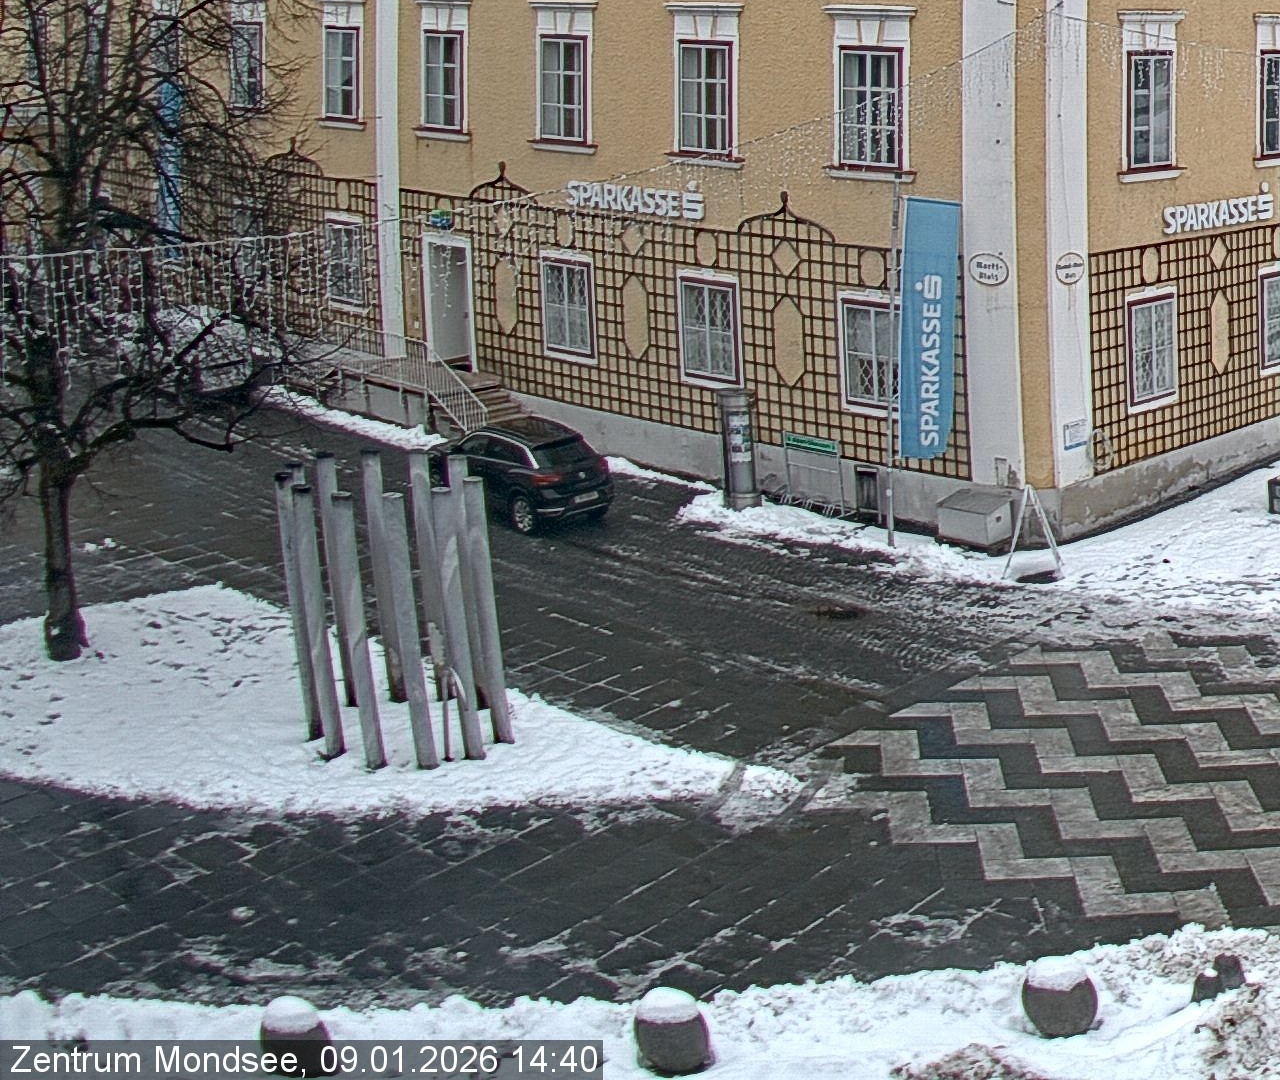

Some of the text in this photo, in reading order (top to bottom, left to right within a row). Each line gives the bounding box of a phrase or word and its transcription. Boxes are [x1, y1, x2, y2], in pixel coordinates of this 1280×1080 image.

[567, 180, 680, 217] SPARKASSE
[1164, 196, 1257, 234] SPARKASSE
[920, 303, 941, 447] SPARKASSE
